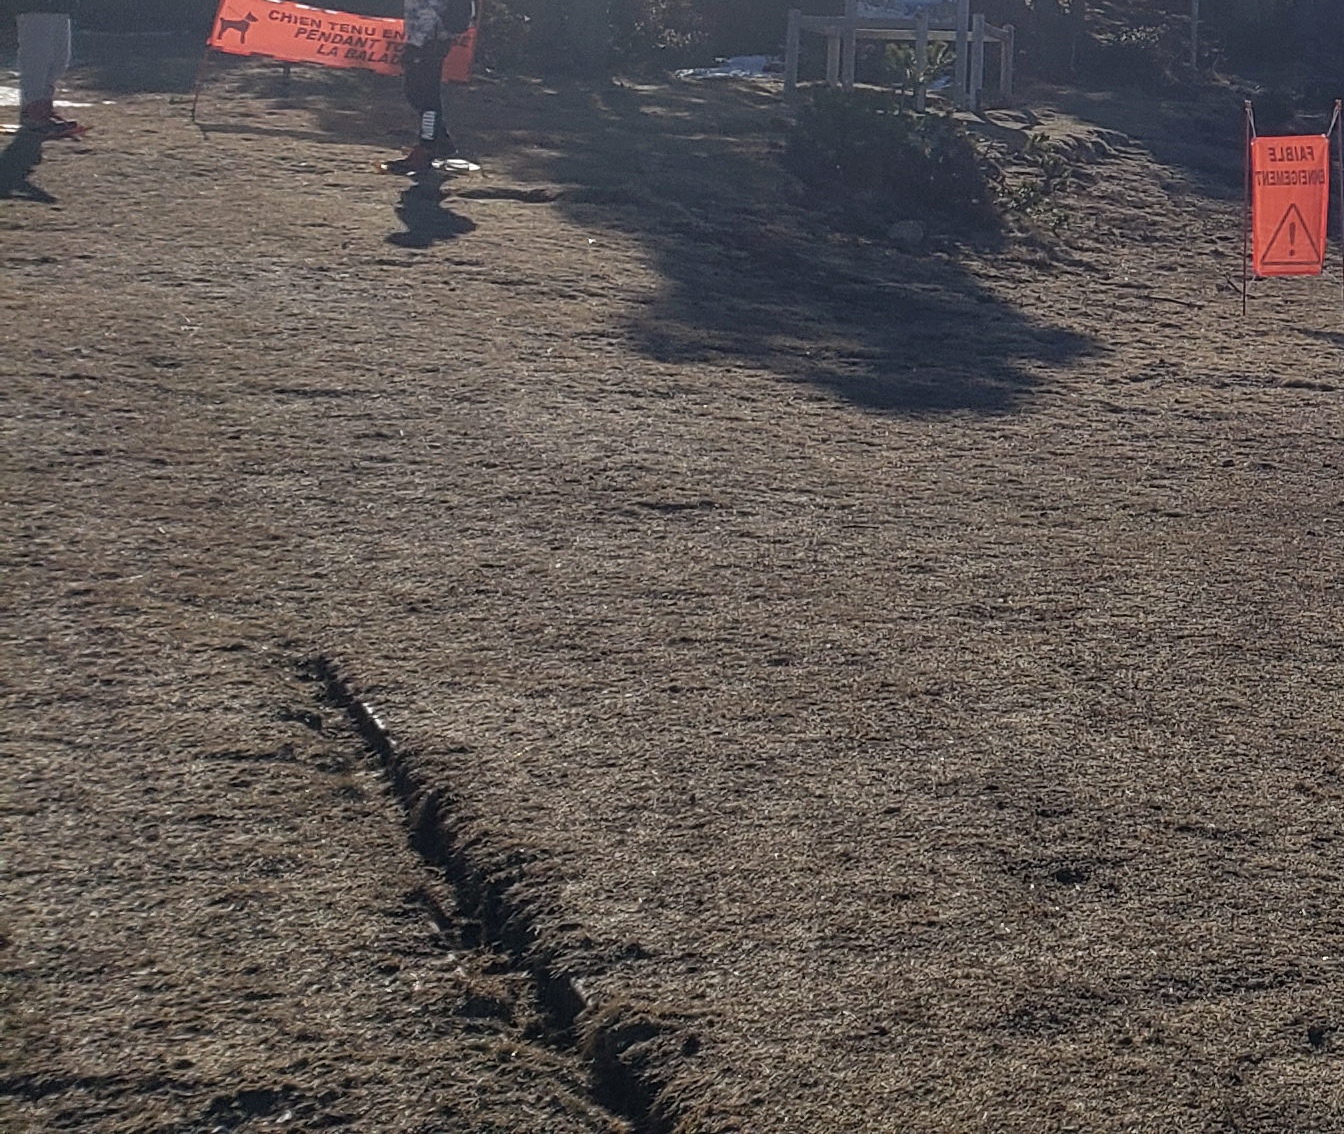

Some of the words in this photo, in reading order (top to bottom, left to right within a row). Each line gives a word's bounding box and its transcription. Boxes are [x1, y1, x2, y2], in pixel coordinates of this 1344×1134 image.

[268, 9, 322, 29] CHIEN
[329, 21, 376, 36] TENU
[382, 28, 405, 41] EN
[294, 27, 381, 50] PENDANT
[316, 43, 338, 57] LA
[344, 47, 402, 66] BALAD
